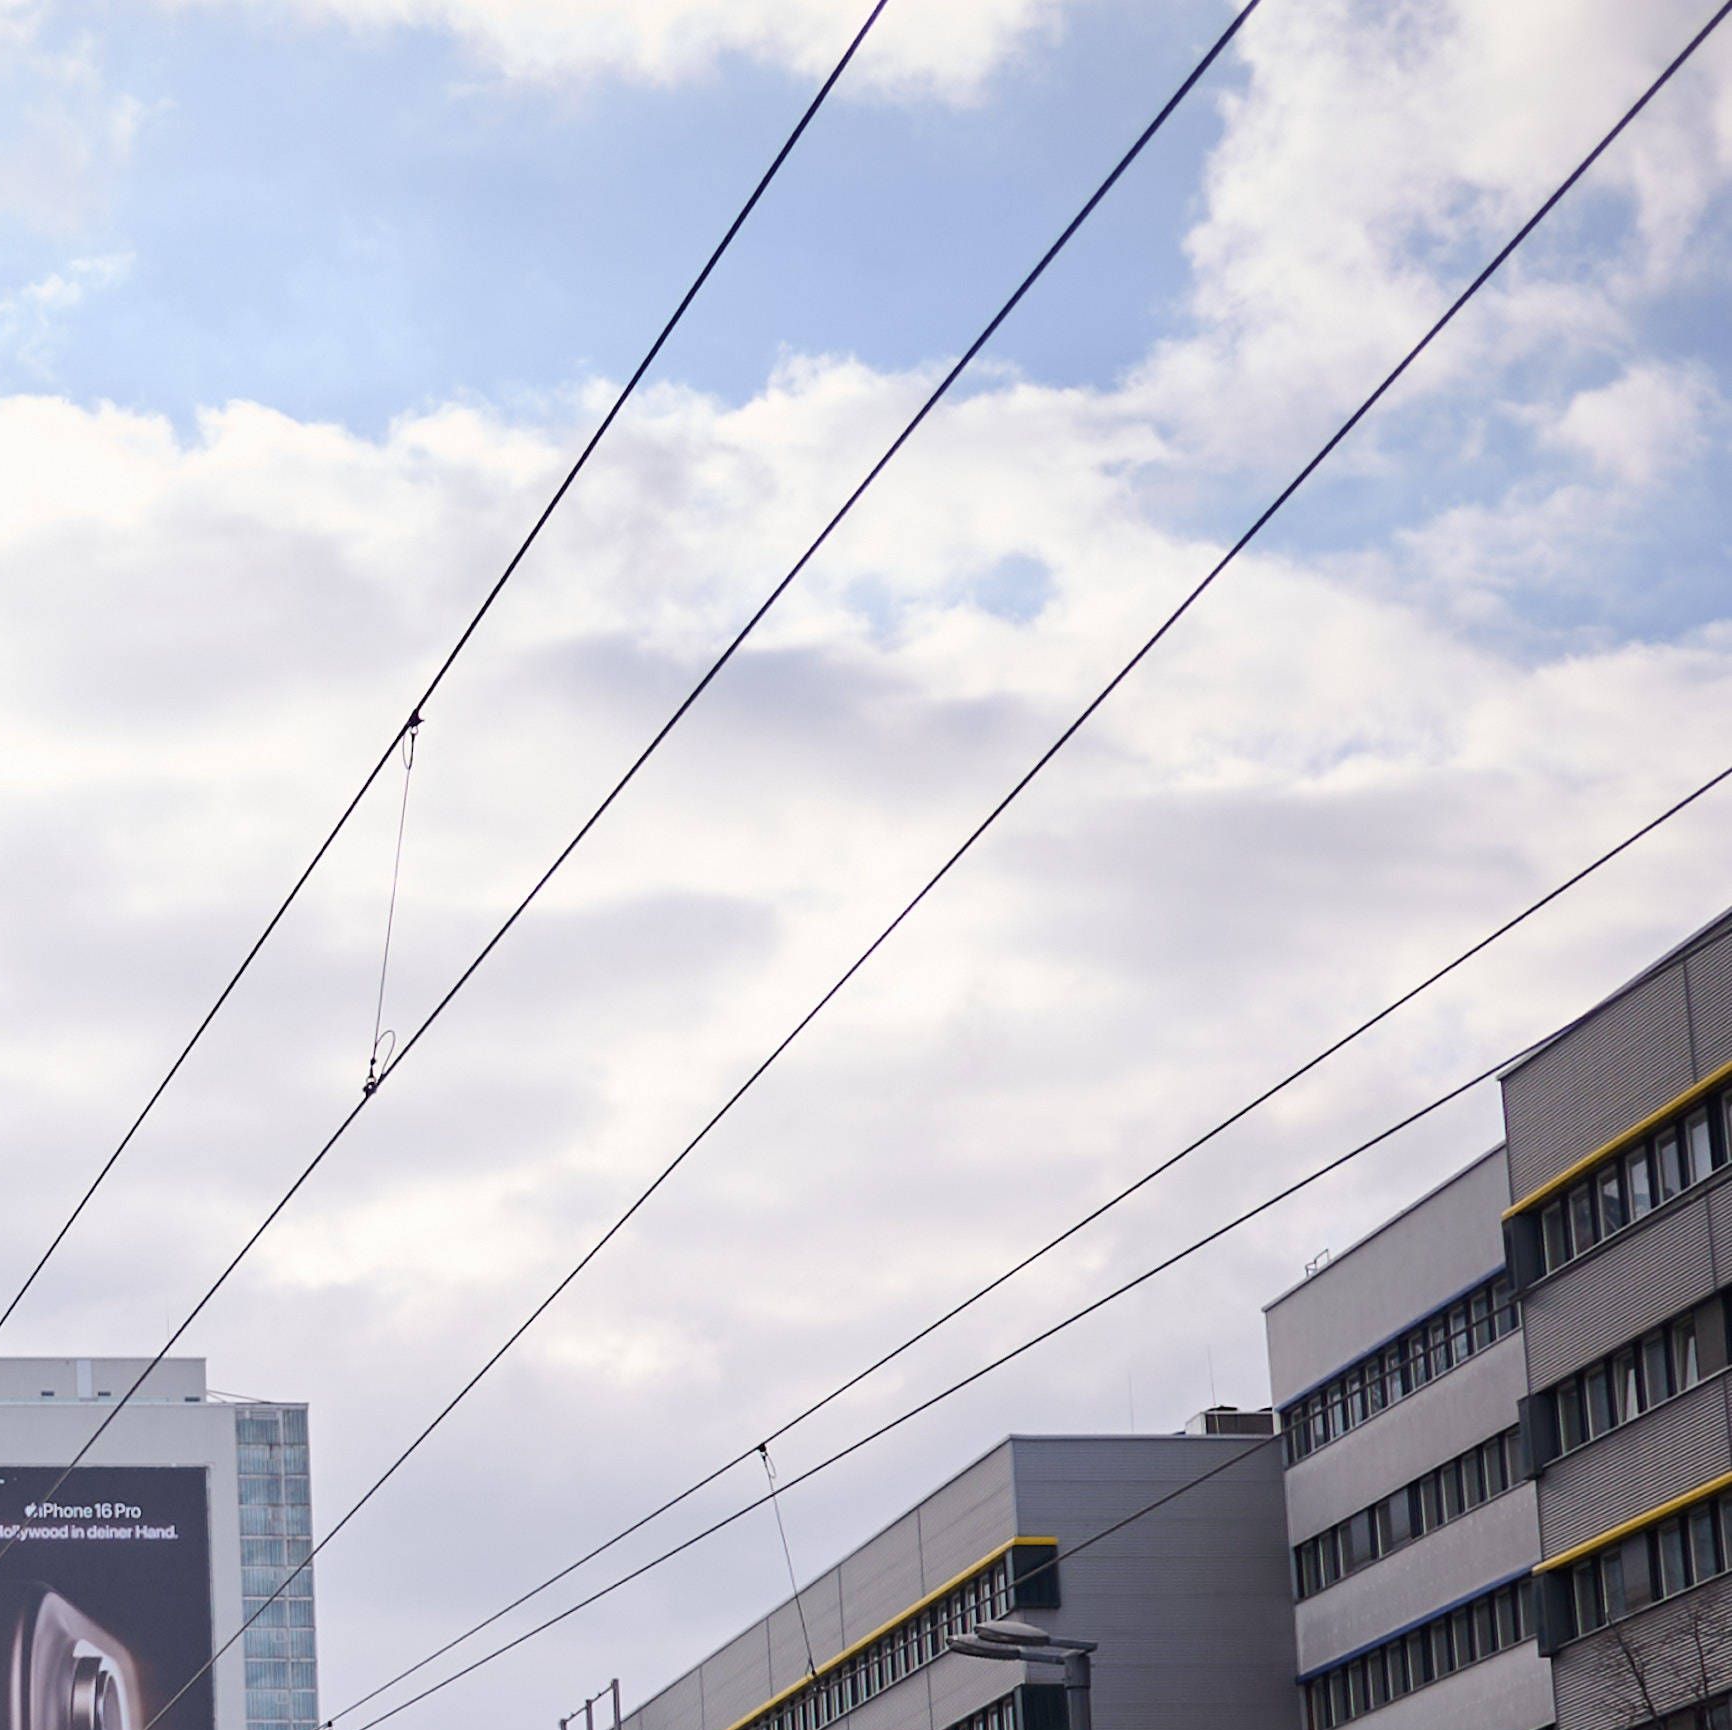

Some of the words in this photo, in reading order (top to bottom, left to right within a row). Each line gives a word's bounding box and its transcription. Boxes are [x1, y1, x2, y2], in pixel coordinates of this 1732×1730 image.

[38, 1503, 93, 1518] iPhone
[95, 1503, 113, 1518] 16
[115, 1503, 142, 1518] Pro
[71, 1525, 85, 1539] in
[87, 1525, 133, 1539] deiner
[135, 1525, 179, 1540] Hand.
